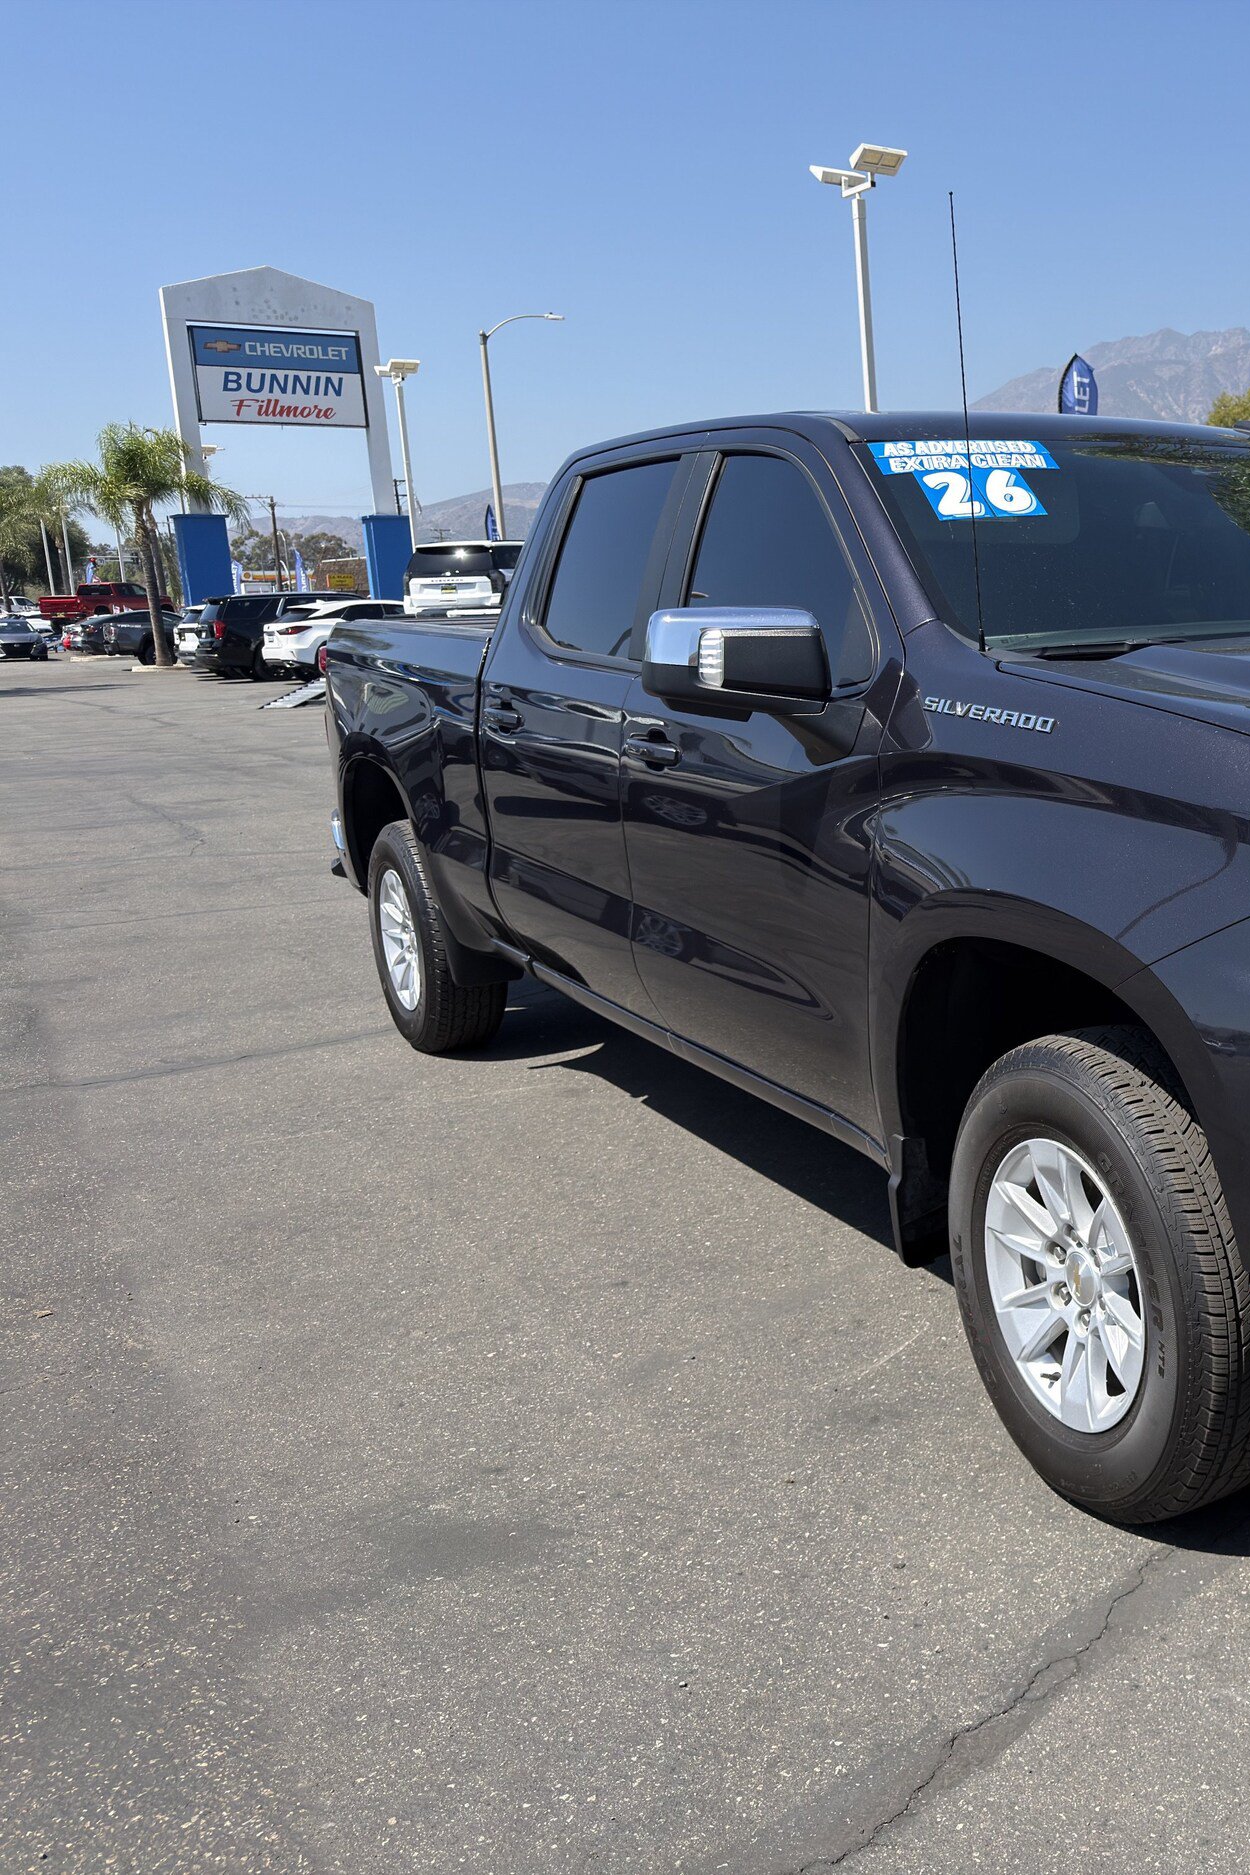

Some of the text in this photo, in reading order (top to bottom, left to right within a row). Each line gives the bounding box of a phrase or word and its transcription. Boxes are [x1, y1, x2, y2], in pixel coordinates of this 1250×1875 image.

[245, 341, 349, 361] CHEVROLET
[222, 371, 344, 397] BUNNIN
[230, 398, 337, 420] Fillmore
[883, 440, 1037, 457] AS ADVERTISED
[890, 453, 1047, 473] EXTRA CLEAN
[922, 469, 1037, 517] 26
[923, 696, 1056, 734] SILVERADO
